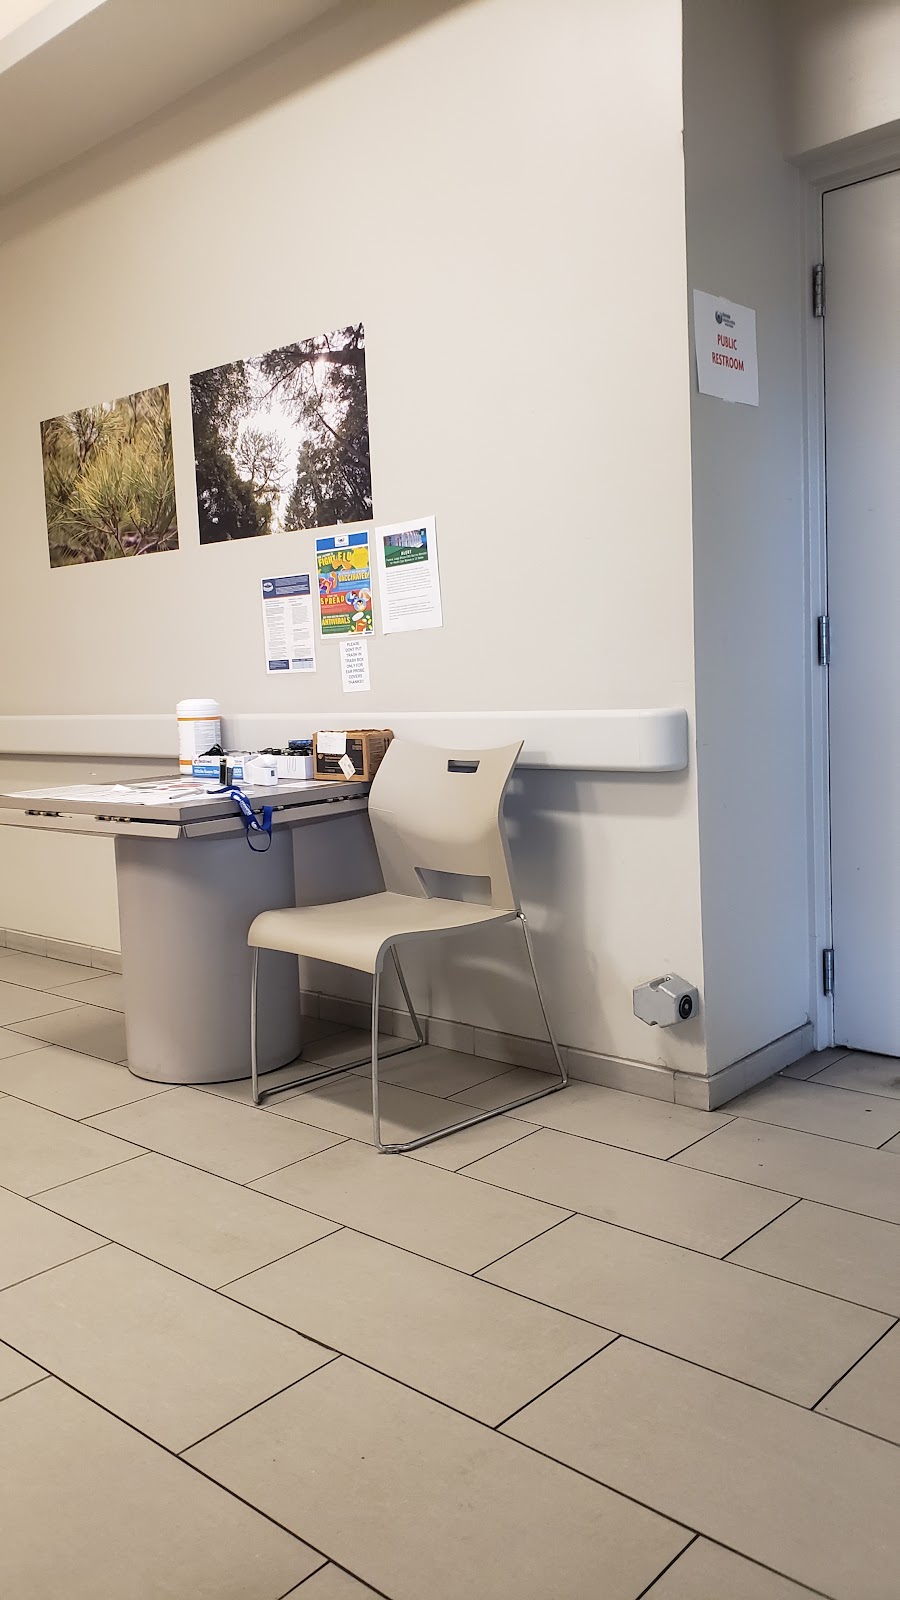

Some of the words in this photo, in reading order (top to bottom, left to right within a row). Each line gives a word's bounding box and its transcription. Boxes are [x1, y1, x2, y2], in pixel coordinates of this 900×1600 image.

[717, 333, 738, 351] PUBLIC
[711, 351, 745, 371] RESTROOM
[320, 595, 345, 605] SPREAD
